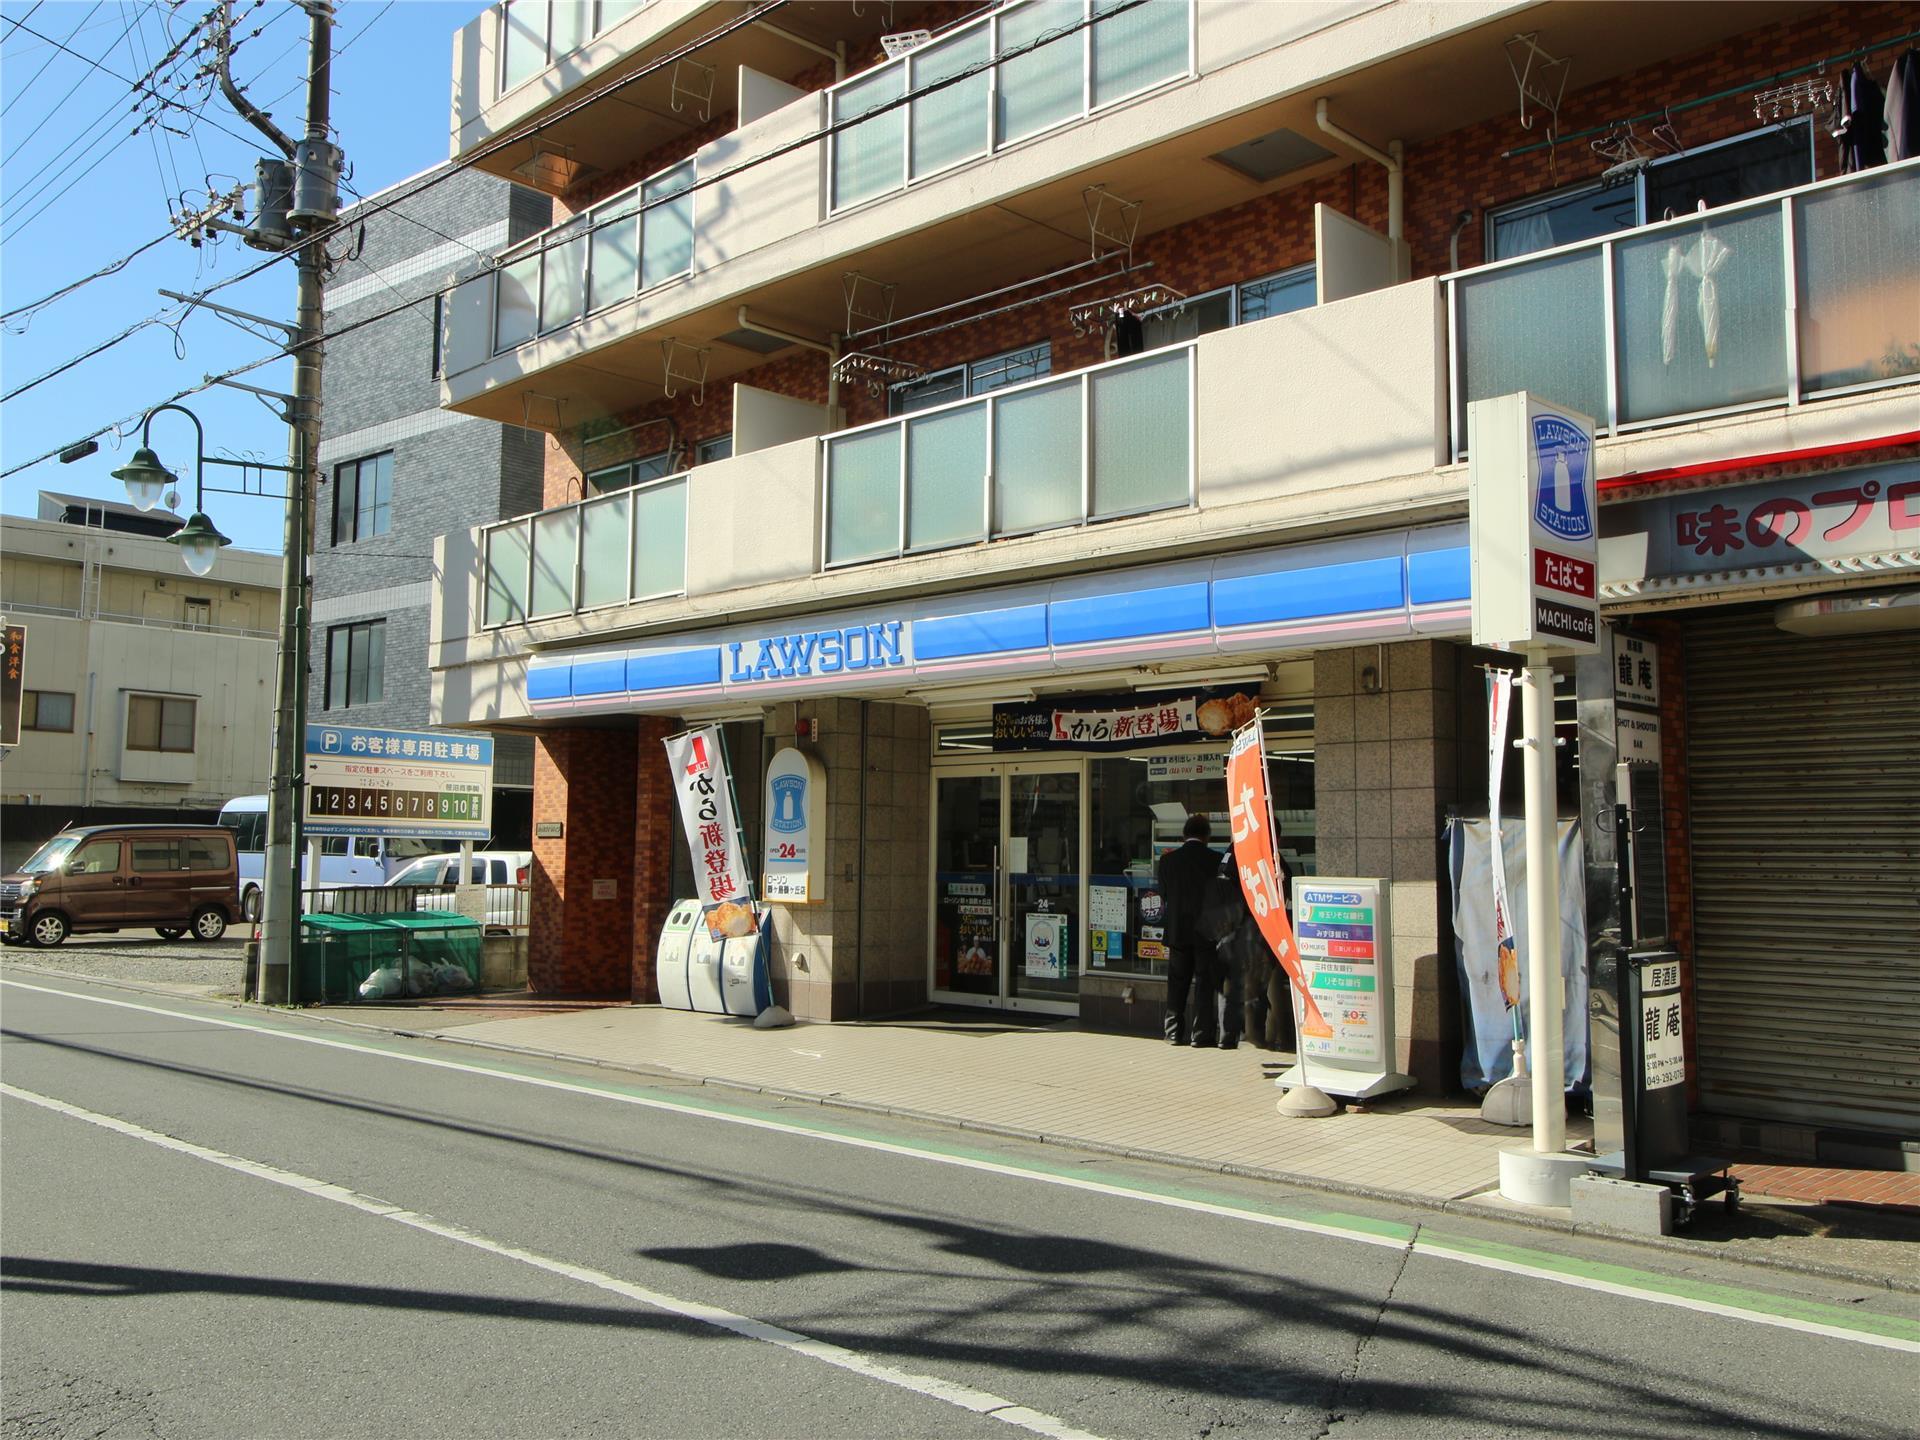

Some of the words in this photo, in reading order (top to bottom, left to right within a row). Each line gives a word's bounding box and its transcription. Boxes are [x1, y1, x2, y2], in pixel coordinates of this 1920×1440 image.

[1537, 424, 1588, 454] LAWSON
[1540, 503, 1587, 532] STATION
[1545, 557, 1585, 591] たばこ
[1538, 608, 1572, 631] MACHI
[1573, 618, 1593, 635] café
[729, 621, 904, 682] LAWSON
[326, 733, 337, 749] P
[351, 735, 479, 761] お客様専用駐車場
[774, 779, 803, 792] LAWSON
[316, 794, 322, 808] 1
[331, 794, 339, 809] 2
[348, 795, 356, 809] 3
[364, 796, 372, 810] 4
[380, 796, 388, 810] 5
[396, 797, 403, 811] 6
[412, 798, 419, 812] 7
[427, 799, 434, 812] 8
[442, 799, 449, 813] 9
[454, 800, 467, 813] 10
[774, 819, 803, 830] STATION
[779, 843, 796, 858] 24
[768, 875, 787, 884] ローソン
[1038, 898, 1049, 908] 24
[1307, 893, 1359, 904] ATMサービス
[1316, 930, 1349, 939] みずほ銀行
[1325, 977, 1361, 988] りそな銀行
[1651, 966, 1677, 988] 居酒屋
[1645, 1003, 1680, 1041] 龍庵
